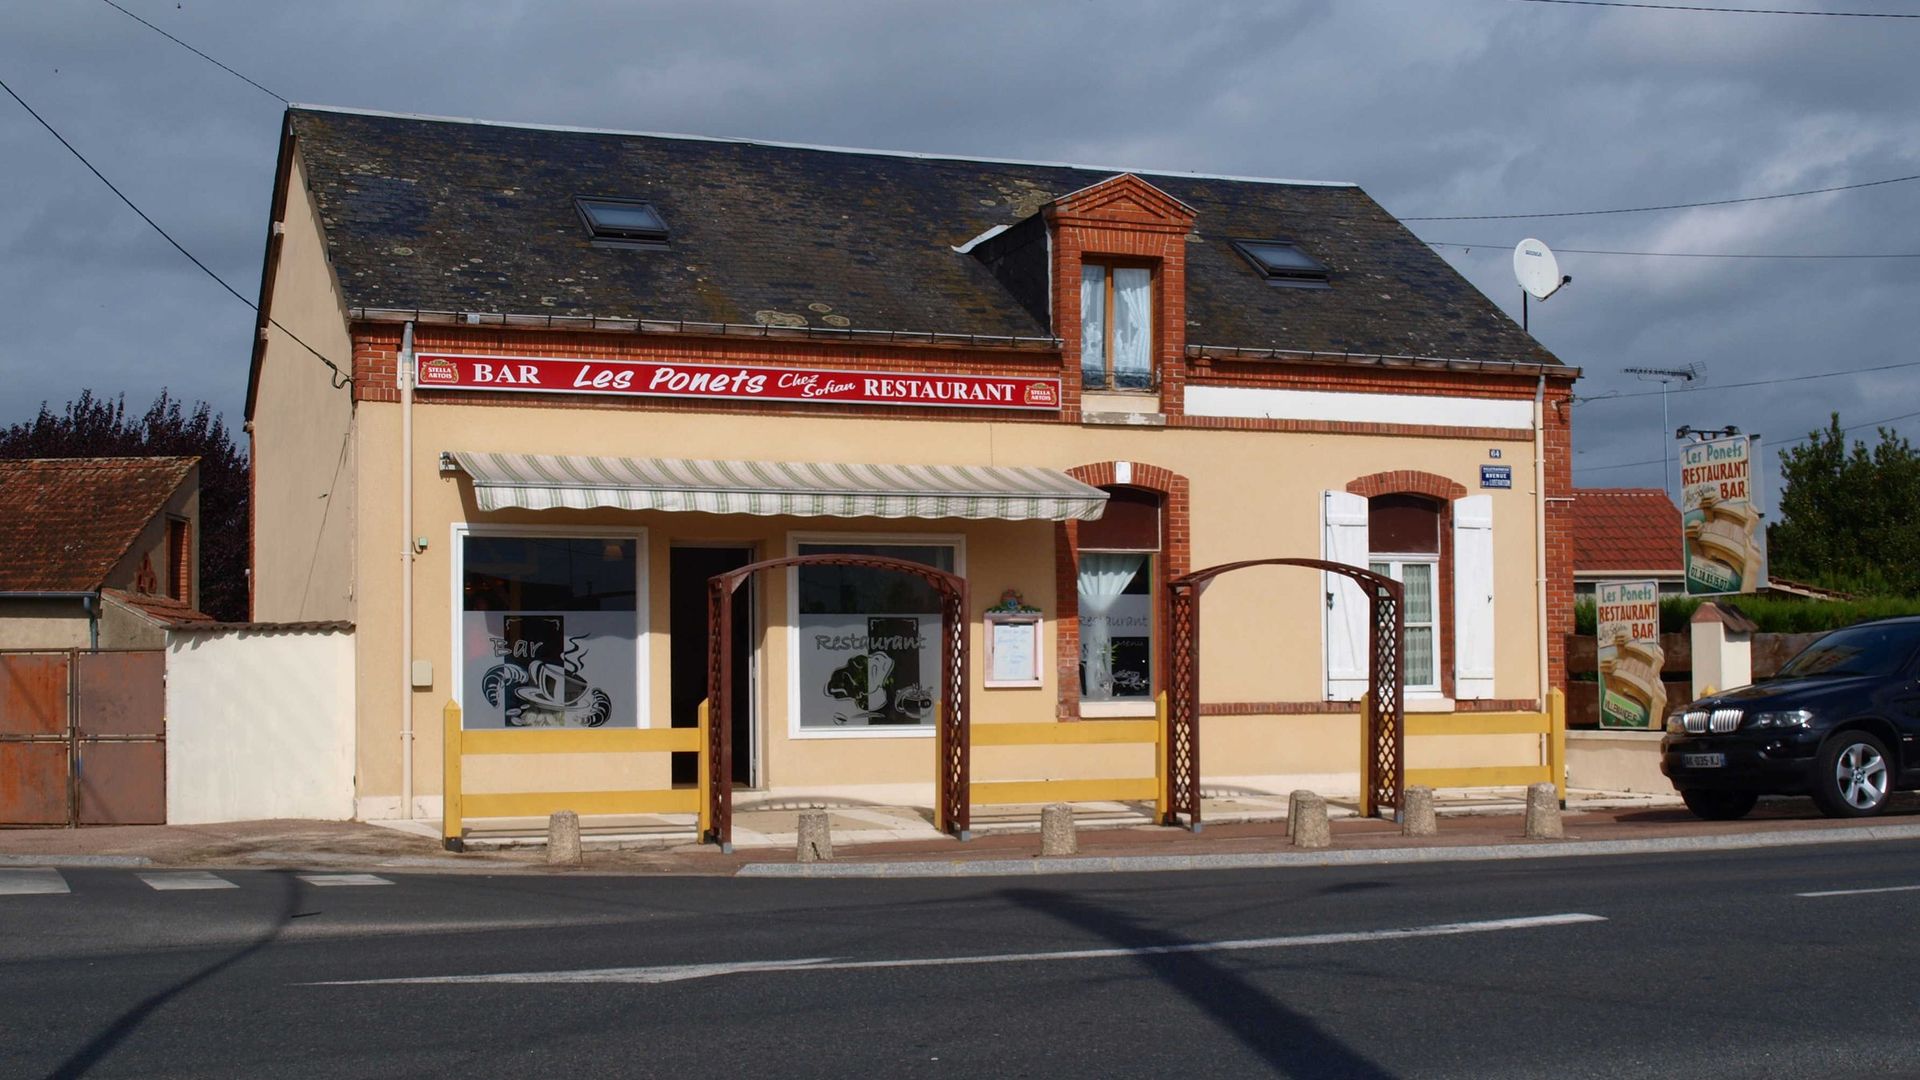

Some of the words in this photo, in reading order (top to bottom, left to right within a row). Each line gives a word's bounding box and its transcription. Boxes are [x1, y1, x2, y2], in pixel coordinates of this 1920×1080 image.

[428, 366, 451, 374] STELLA
[472, 363, 541, 384] BAR
[573, 365, 635, 389] Les
[649, 367, 767, 393] Ponets
[777, 372, 819, 388] Chez
[801, 380, 856, 397] Sofian
[864, 378, 1015, 401] RESTAURANT
[1685, 448, 1702, 466] Les
[1706, 443, 1742, 461] Ponets
[1682, 459, 1748, 488] RESTAURANT
[1720, 481, 1746, 499] BAR
[1601, 587, 1616, 603] Les
[1620, 584, 1652, 601] Ponets
[1598, 602, 1657, 625] RESTAURANT
[1632, 623, 1654, 639] BAR
[488, 636, 544, 658] Bar
[815, 632, 927, 652] Restaurant
